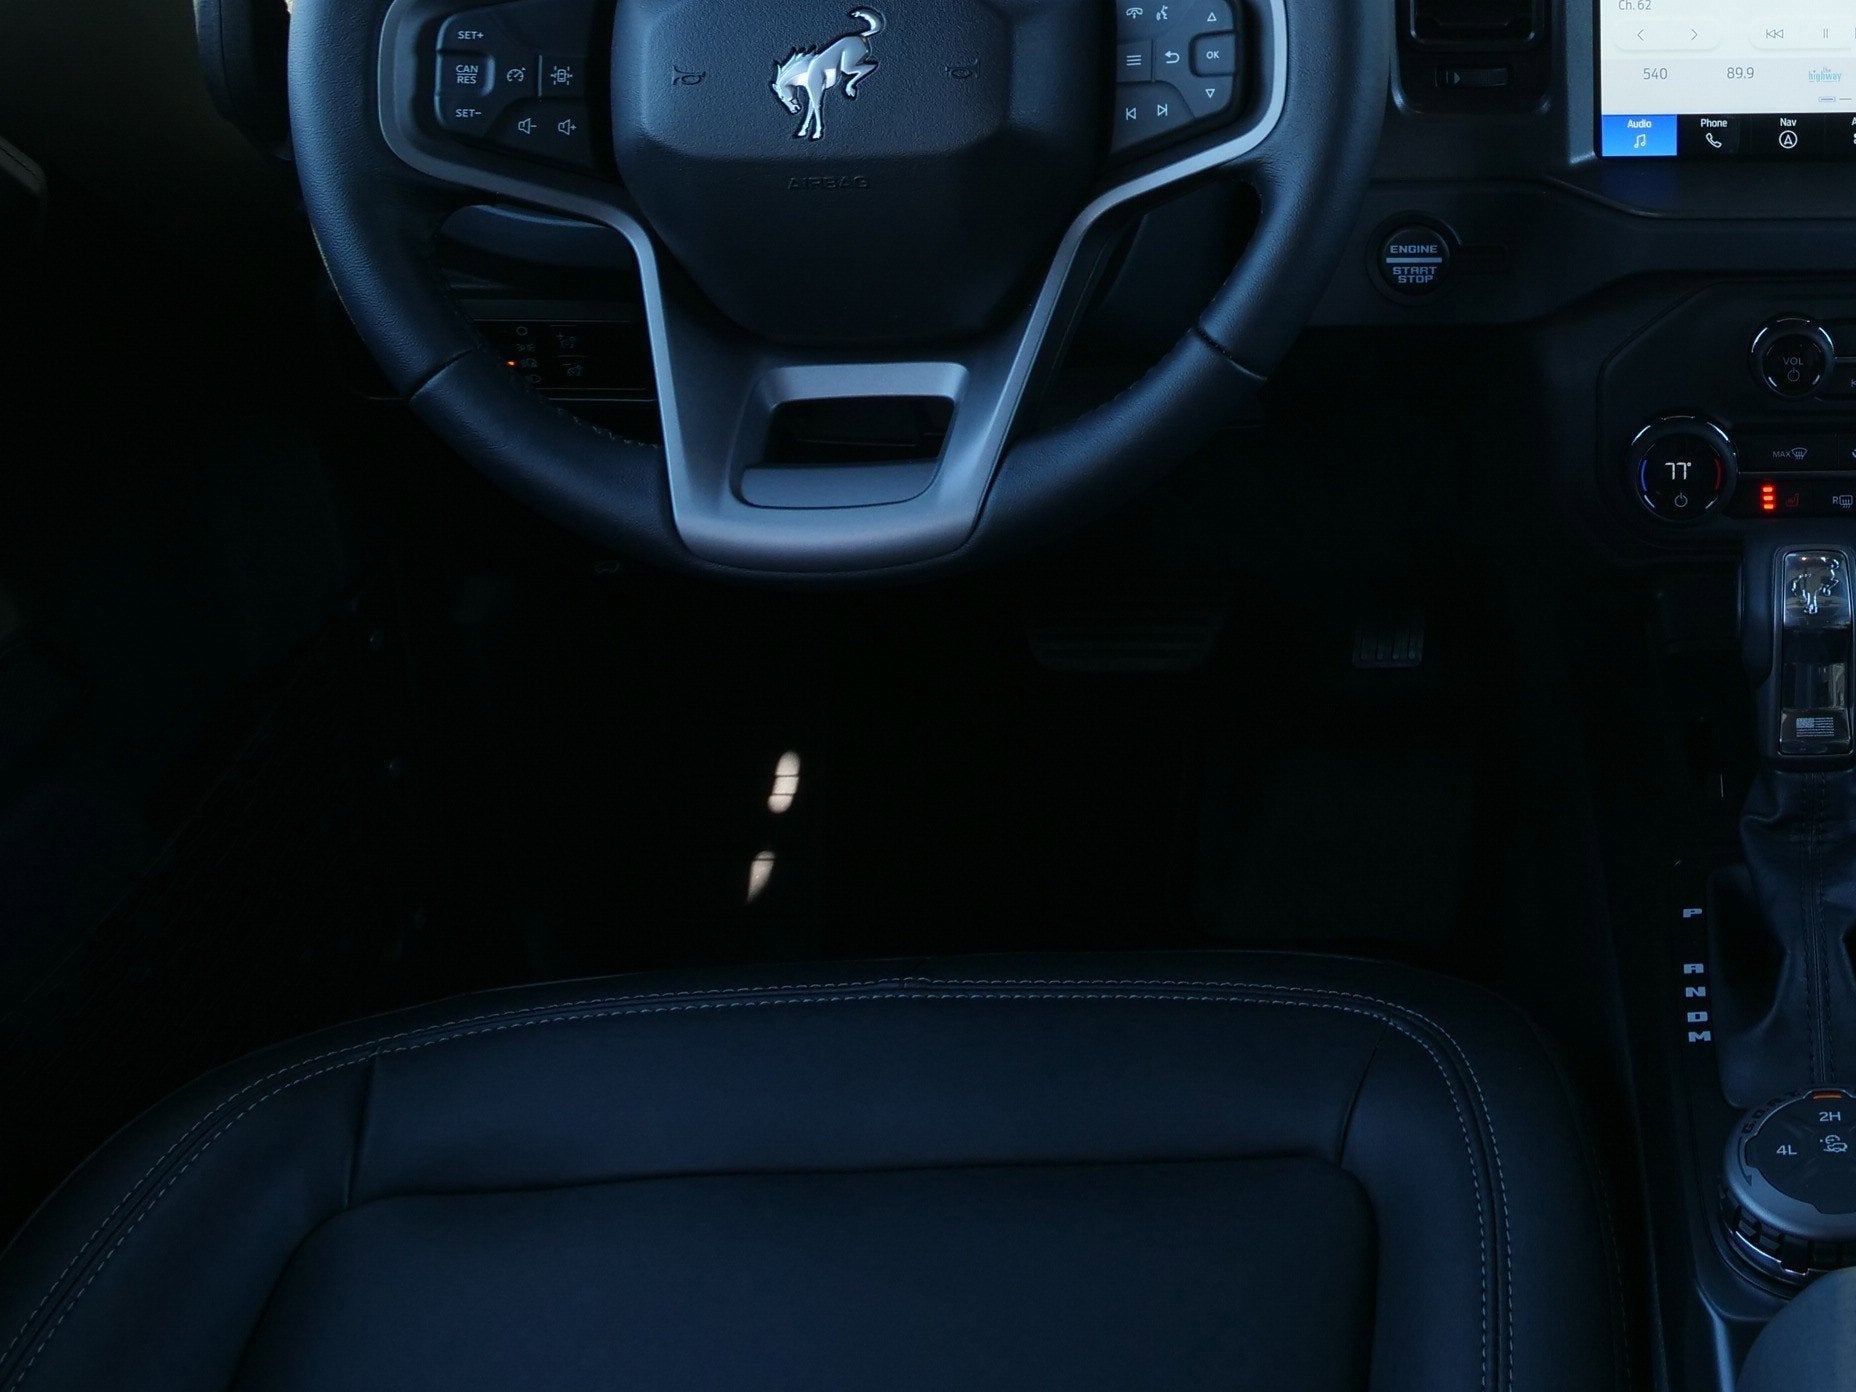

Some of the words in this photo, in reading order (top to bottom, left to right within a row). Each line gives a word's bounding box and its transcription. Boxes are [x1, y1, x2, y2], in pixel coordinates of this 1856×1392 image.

[1618, 0, 1636, 11] Ch.
[1637, 0, 1652, 11] 62
[457, 30, 484, 40] SET+
[1205, 50, 1220, 60] OK
[455, 64, 479, 74] CAN
[1643, 67, 1668, 80] 540
[1726, 66, 1755, 80] 89.9
[456, 75, 477, 85] RES
[1627, 119, 1652, 129] Audio
[1700, 118, 1728, 128] Phone
[1779, 117, 1797, 127] Nav
[1389, 244, 1438, 254] ENGINE
[1392, 266, 1437, 275] START
[1397, 274, 1434, 284] STOP
[1782, 356, 1804, 366] VOL
[1772, 450, 1790, 459] MAX
[1682, 907, 1703, 919] P
[1685, 986, 1707, 998] N
[1686, 1011, 1709, 1023] D
[1688, 1030, 1712, 1043] M
[1818, 1111, 1842, 1123] 2H
[1776, 1144, 1798, 1156] 4L
